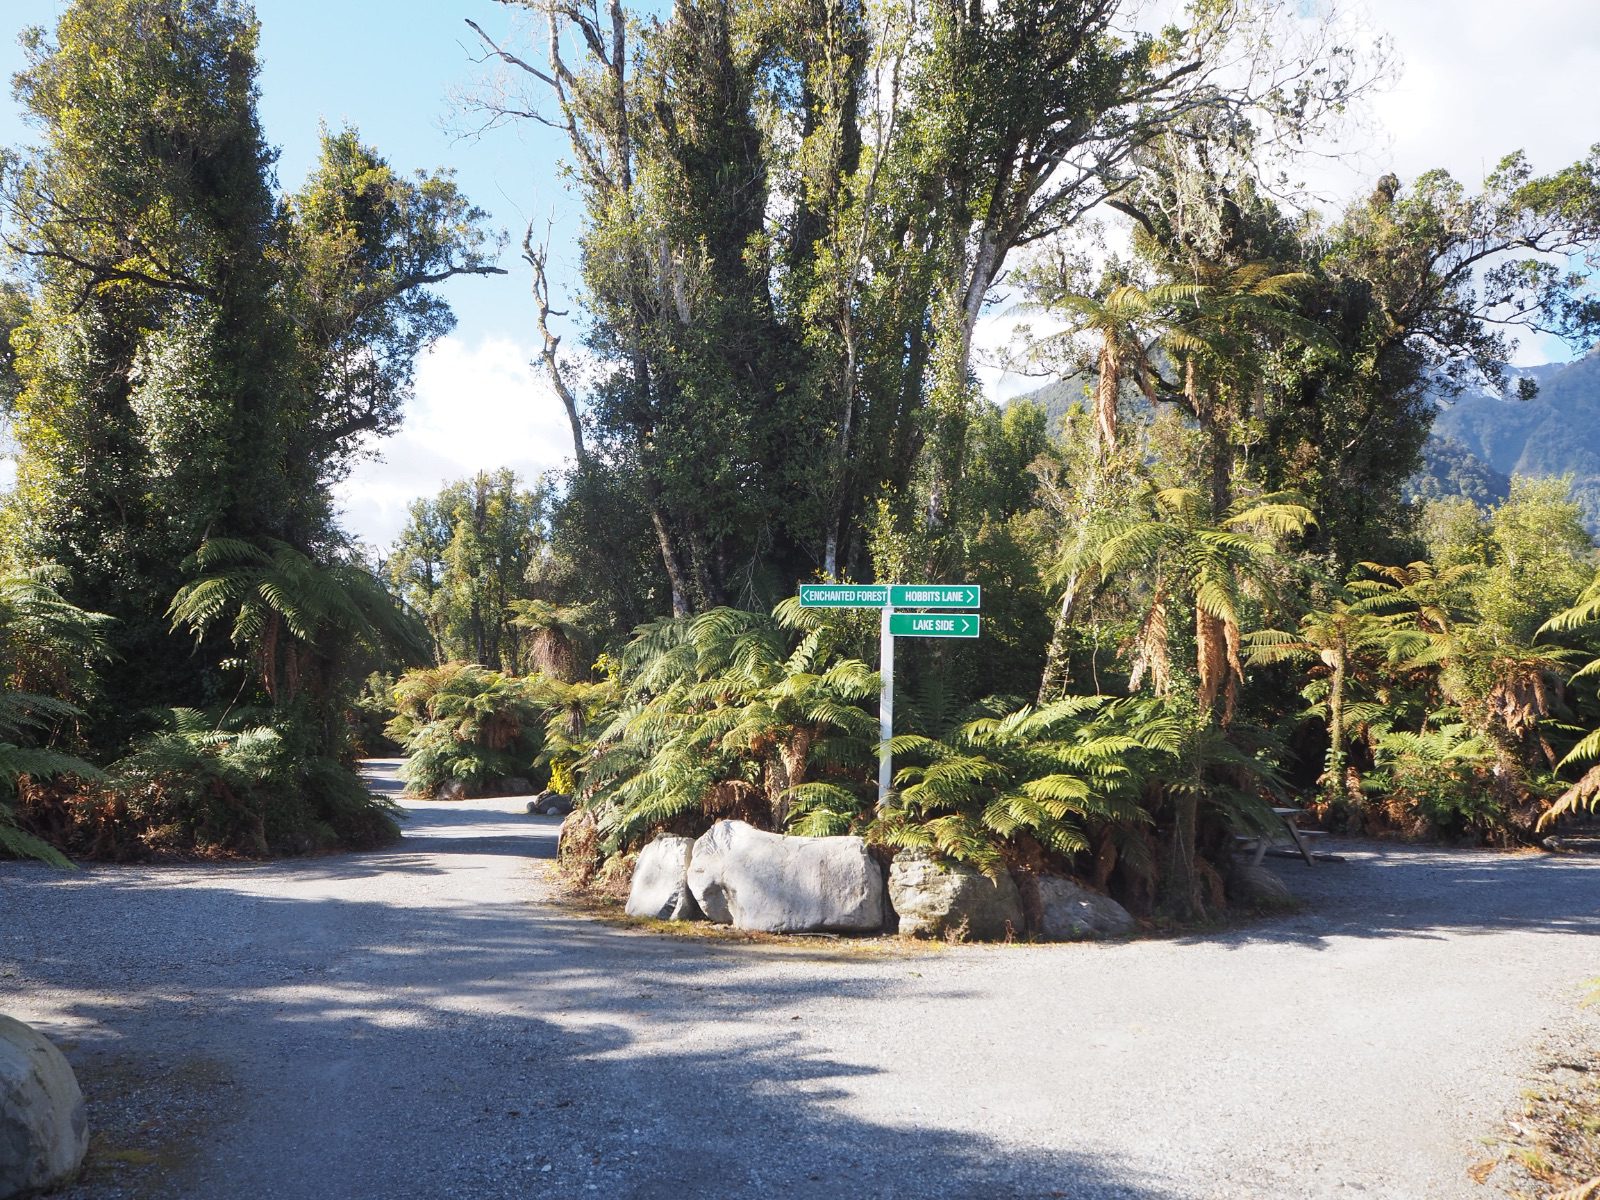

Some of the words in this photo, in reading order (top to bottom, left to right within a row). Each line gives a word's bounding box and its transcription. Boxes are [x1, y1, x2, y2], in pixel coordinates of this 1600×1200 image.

[809, 590, 855, 602] ENCHANTED
[856, 590, 887, 602] FOREST
[905, 590, 940, 602] HOBBITS
[941, 590, 963, 602] LANE
[912, 619, 933, 631] LAKE
[934, 619, 954, 631] SIDE
